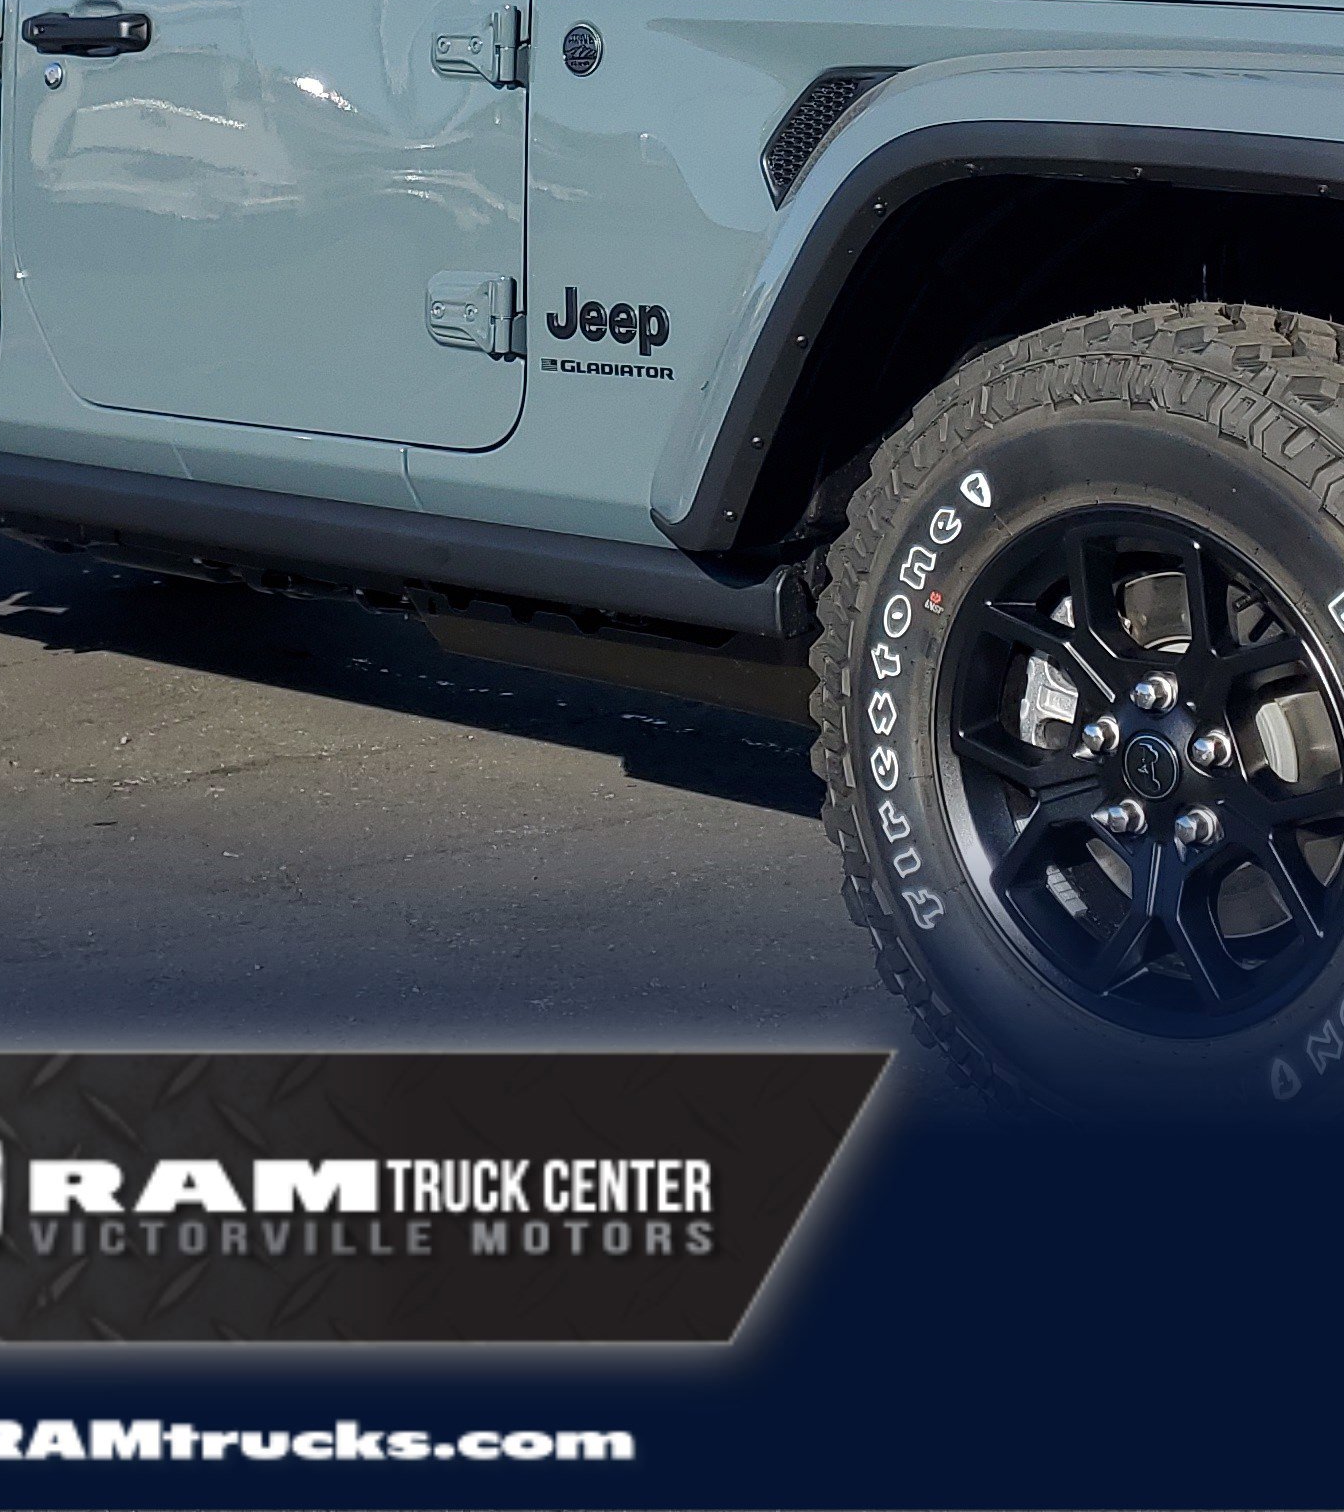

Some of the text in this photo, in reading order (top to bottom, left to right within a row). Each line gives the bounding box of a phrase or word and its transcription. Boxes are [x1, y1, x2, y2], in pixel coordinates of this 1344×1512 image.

[546, 287, 670, 356] Jeep
[560, 359, 675, 381] GLADIATOR
[867, 507, 963, 929] Firestone
